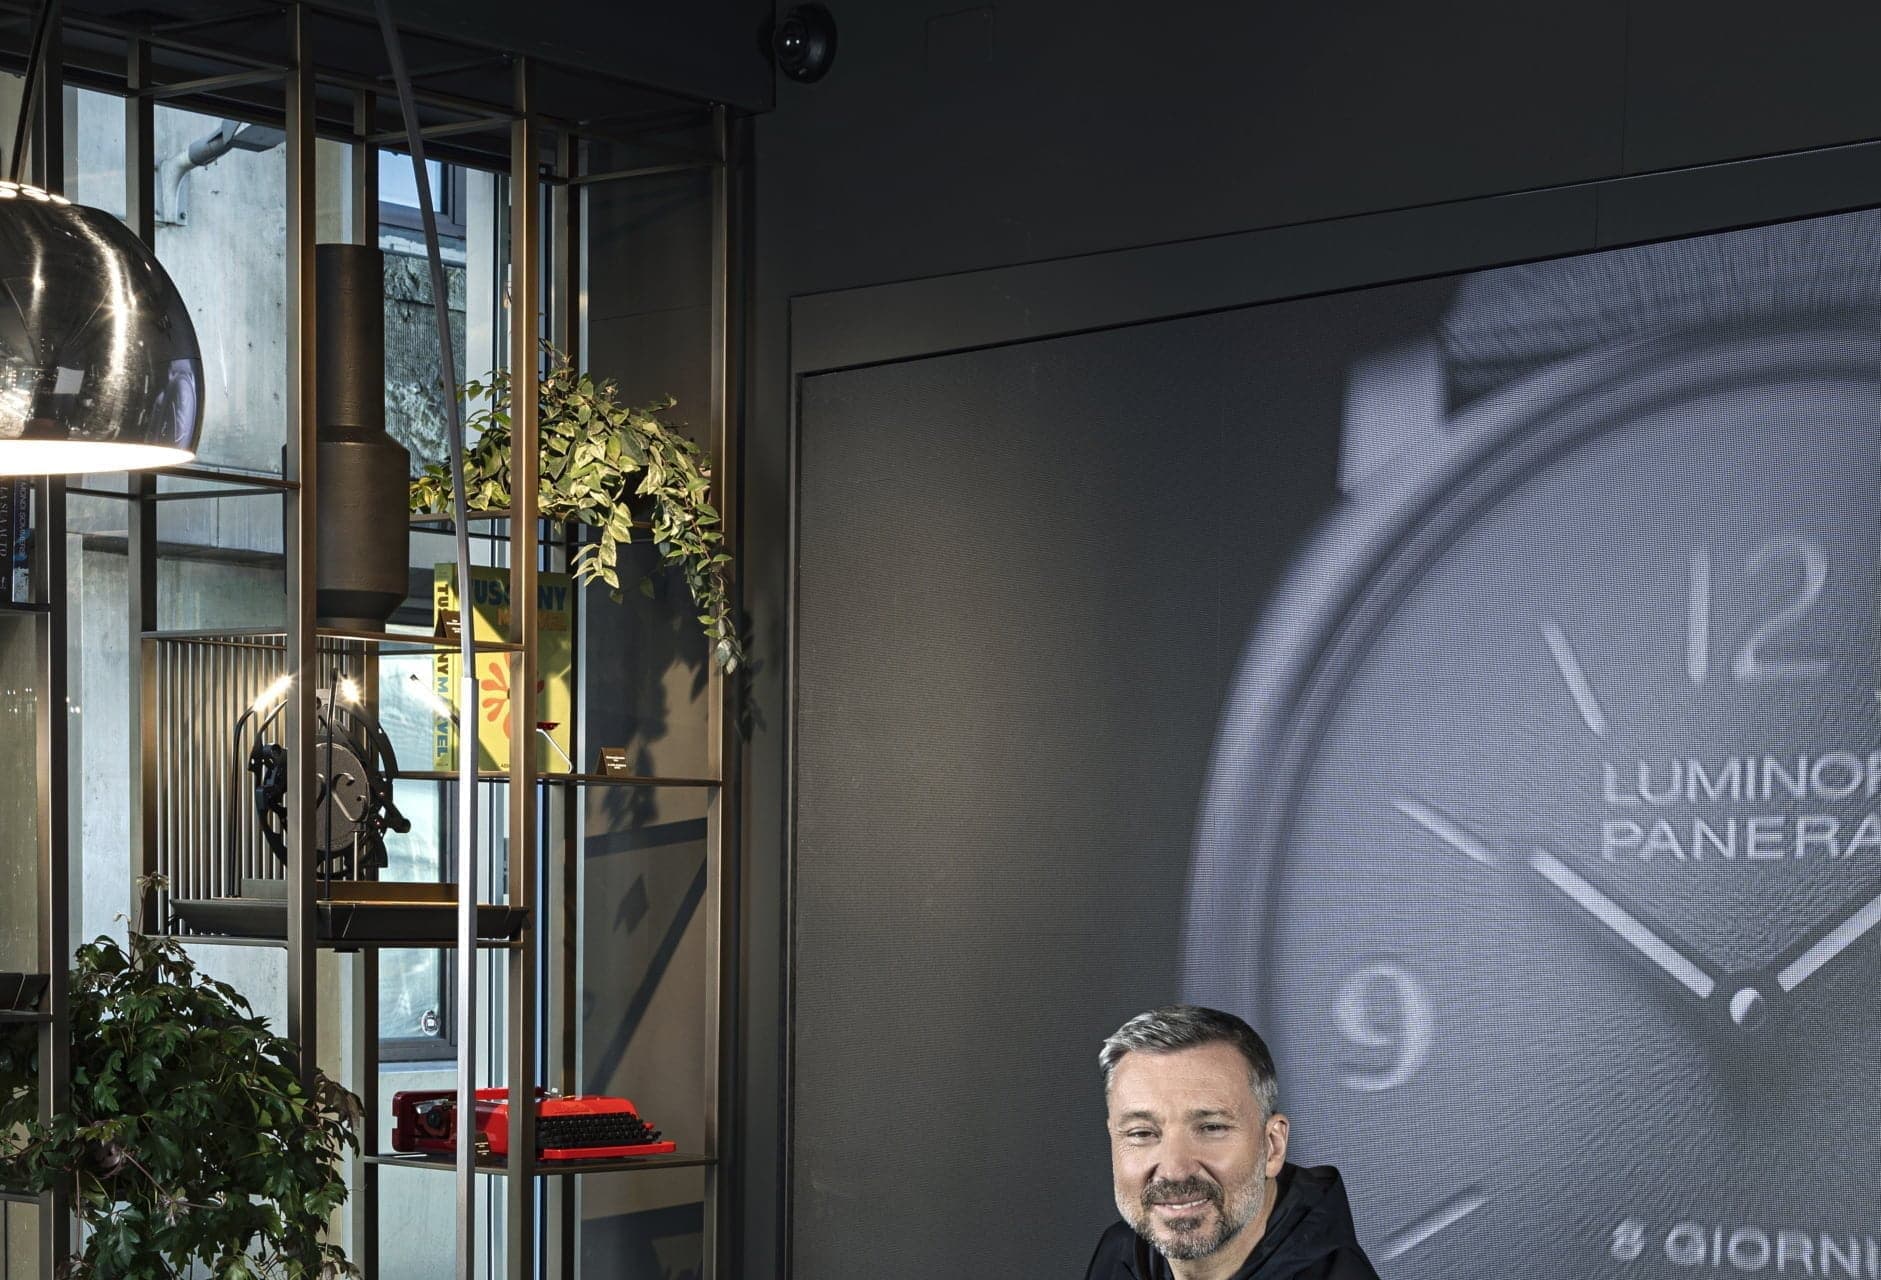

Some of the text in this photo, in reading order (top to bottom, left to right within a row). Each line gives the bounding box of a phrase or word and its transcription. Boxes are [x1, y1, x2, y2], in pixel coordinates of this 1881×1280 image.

[437, 584, 449, 675] TUNY
[1687, 538, 1836, 682] 12
[437, 677, 449, 757] MVEL
[1331, 964, 1432, 1090] 9
[1610, 1218, 1881, 1280] 8 GIORNI
